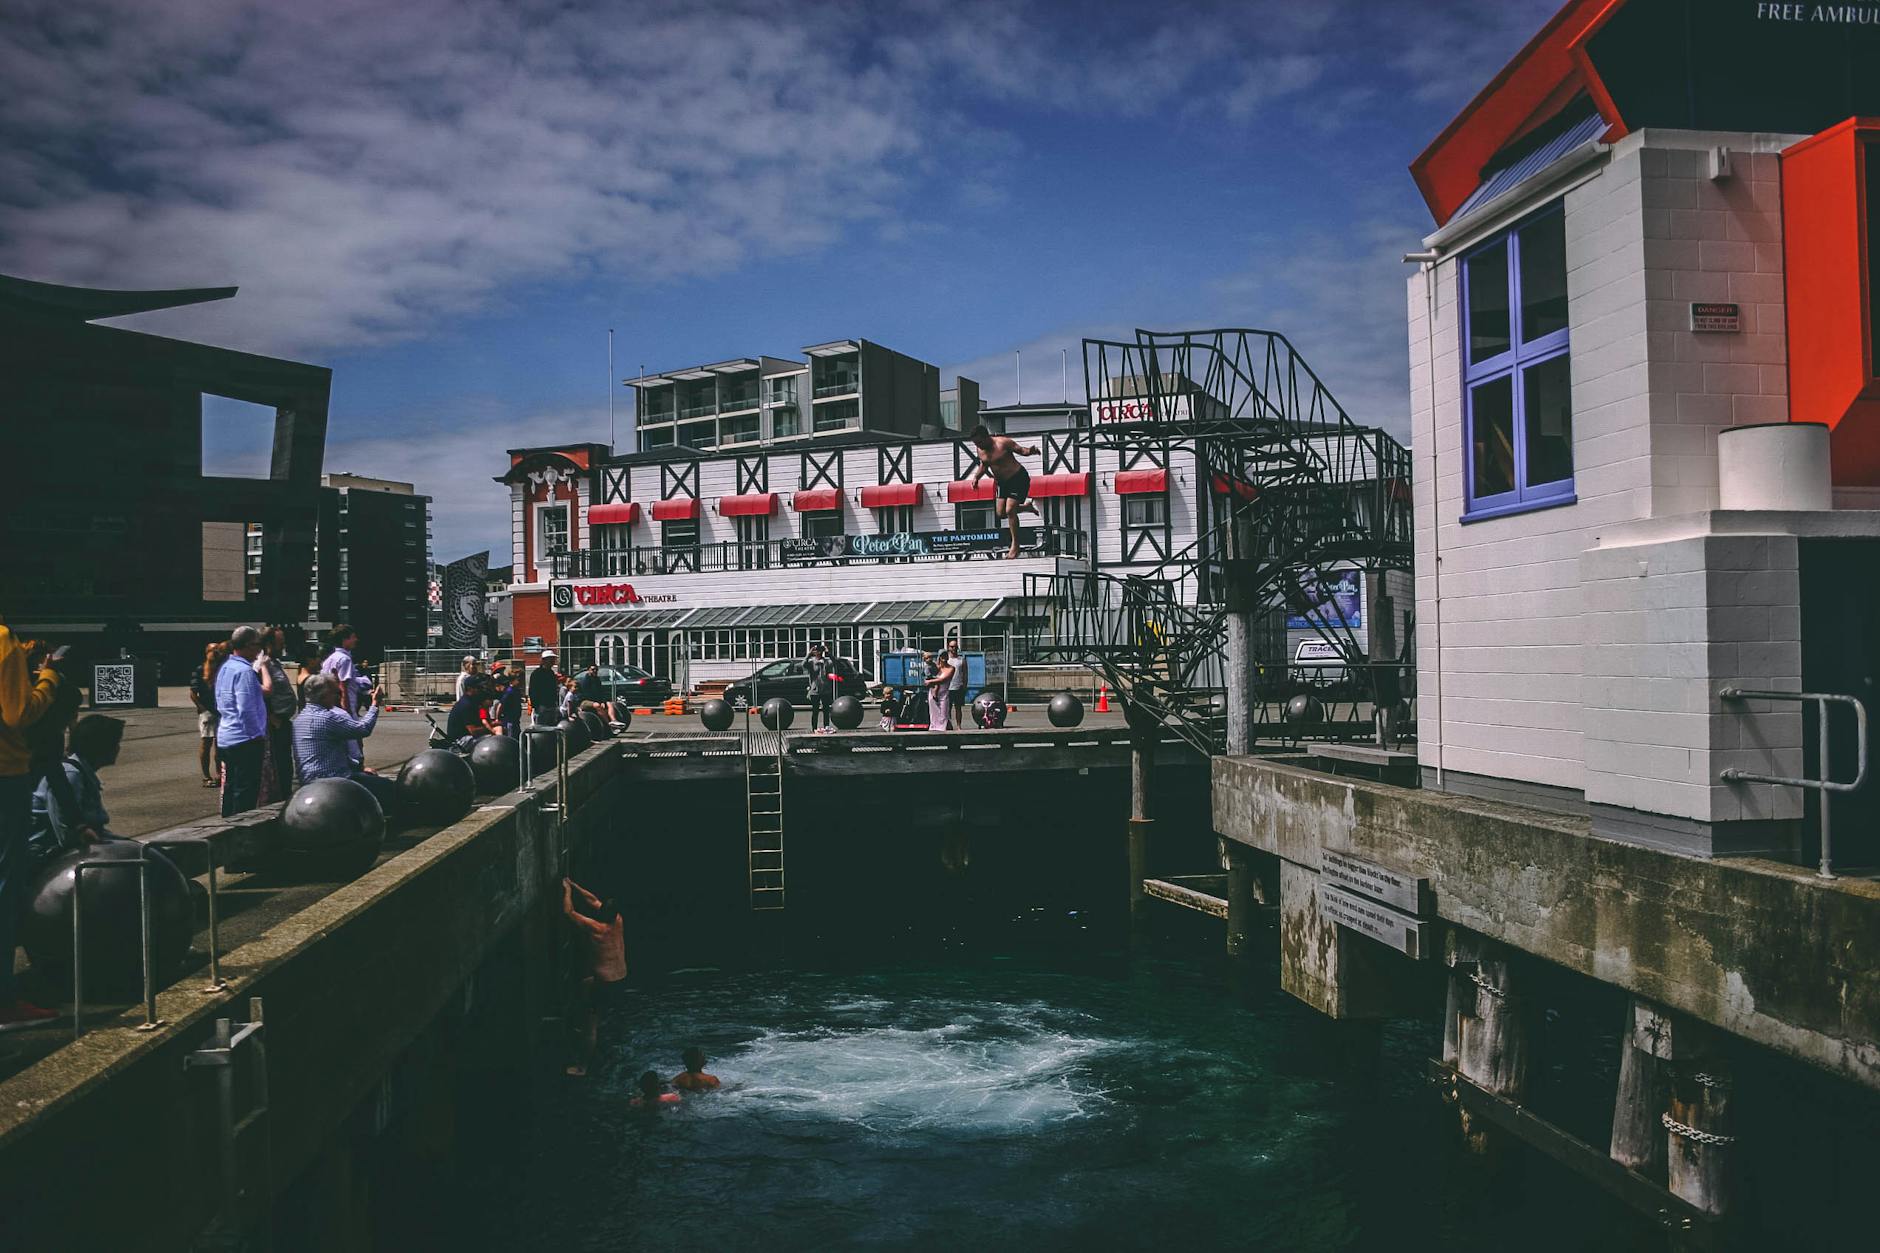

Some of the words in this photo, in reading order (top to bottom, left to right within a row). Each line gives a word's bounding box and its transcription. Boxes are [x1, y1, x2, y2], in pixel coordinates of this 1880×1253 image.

[1757, 2, 1804, 21] FREE
[1811, 5, 1880, 24] AMBUL
[853, 534, 893, 555] Peter
[892, 531, 928, 555] Pan
[951, 533, 999, 541] PANTOMIME
[574, 584, 638, 605] CIRCA
[643, 594, 677, 604] THEATRE
